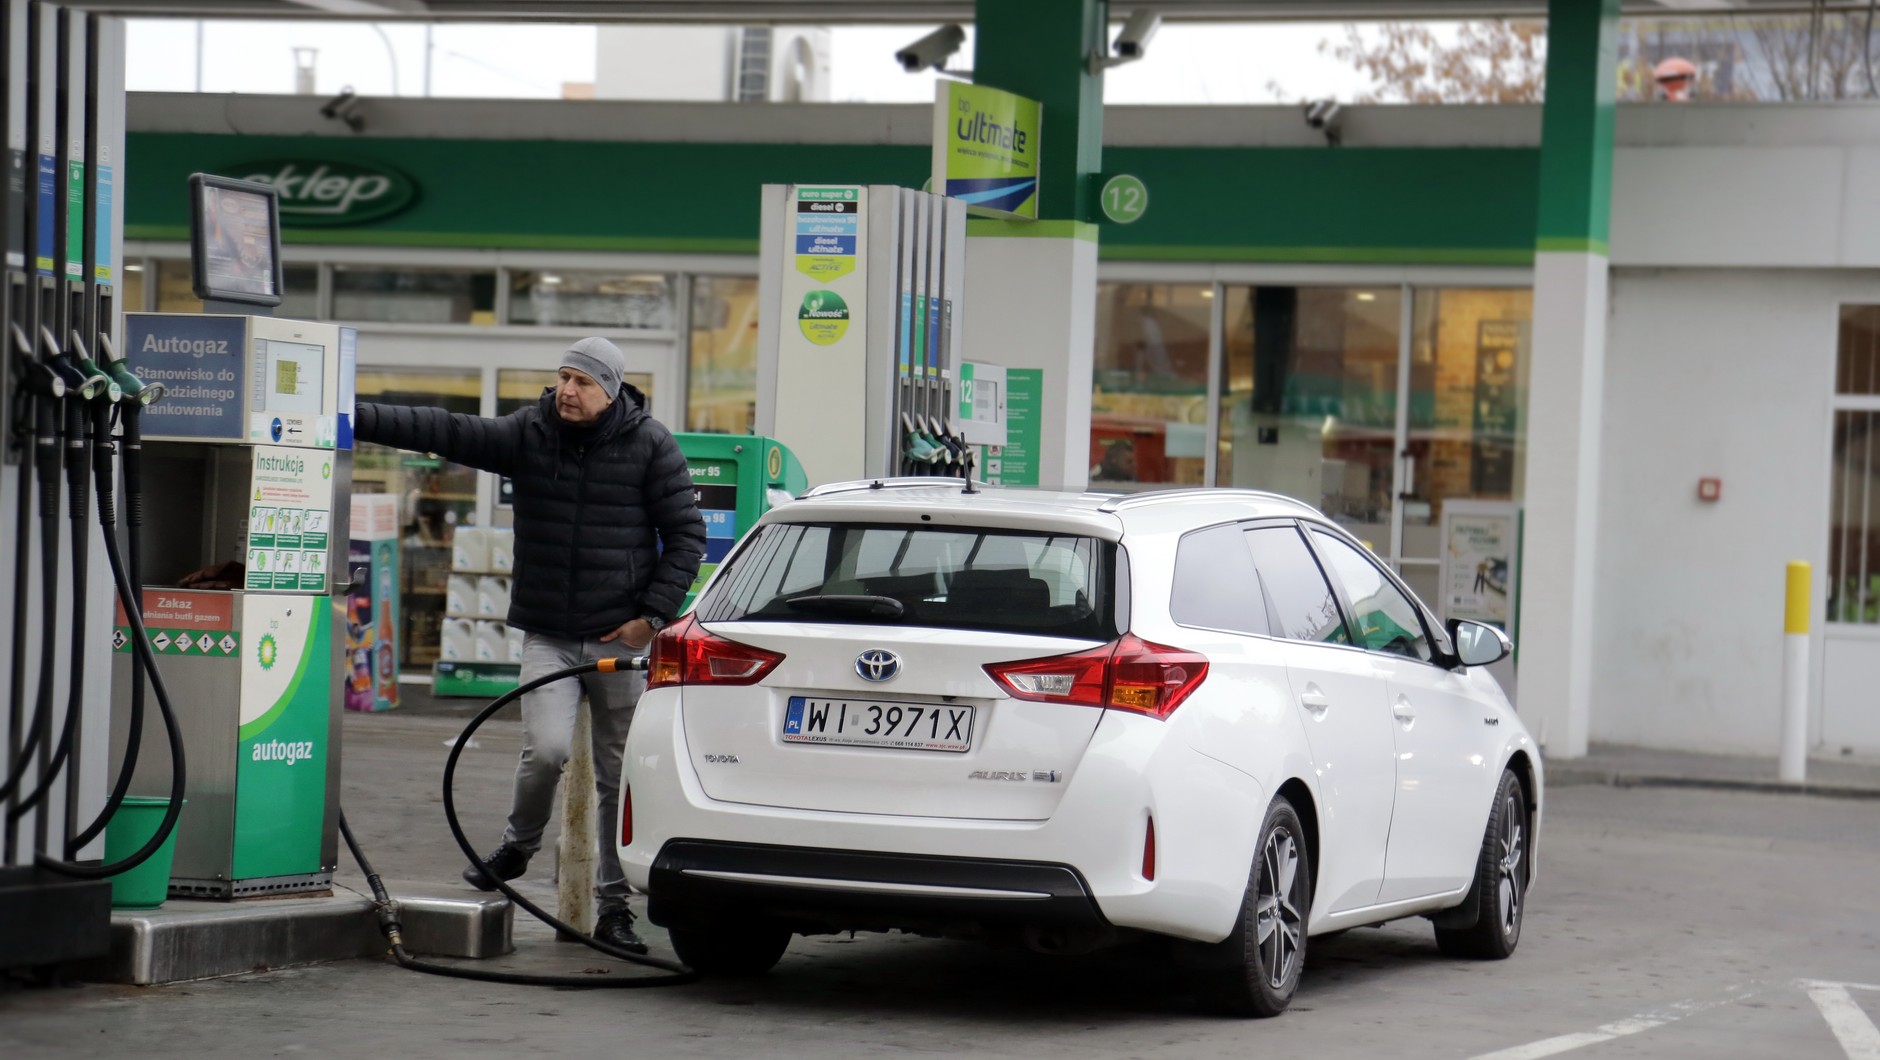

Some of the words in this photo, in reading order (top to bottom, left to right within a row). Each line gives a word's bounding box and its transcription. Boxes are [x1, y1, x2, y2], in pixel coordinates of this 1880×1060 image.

[957, 111, 1026, 154] ultimate
[821, 191, 843, 200] super
[1110, 186, 1139, 212] 12
[810, 203, 834, 212] diesel
[814, 236, 838, 245] diesel
[808, 245, 844, 254] ultimate
[142, 334, 228, 358] Autogaz
[134, 366, 214, 381] Stanowisko
[217, 368, 235, 381] do
[152, 386, 235, 402] odzielnego
[960, 379, 973, 404] 12
[145, 403, 223, 417] tankowania
[256, 452, 304, 477] Instrukcja
[687, 467, 705, 478] per
[708, 466, 720, 477] 95
[713, 513, 725, 523] 98
[157, 597, 192, 609] Zakaz
[175, 612, 193, 620] butli
[194, 614, 220, 623] gazem
[788, 720, 799, 729] PL
[807, 702, 847, 733] WI
[864, 705, 966, 741] 3971X
[252, 738, 313, 765] autogaz
[704, 754, 740, 763] TOYOTA
[968, 770, 1027, 781] AURIS
